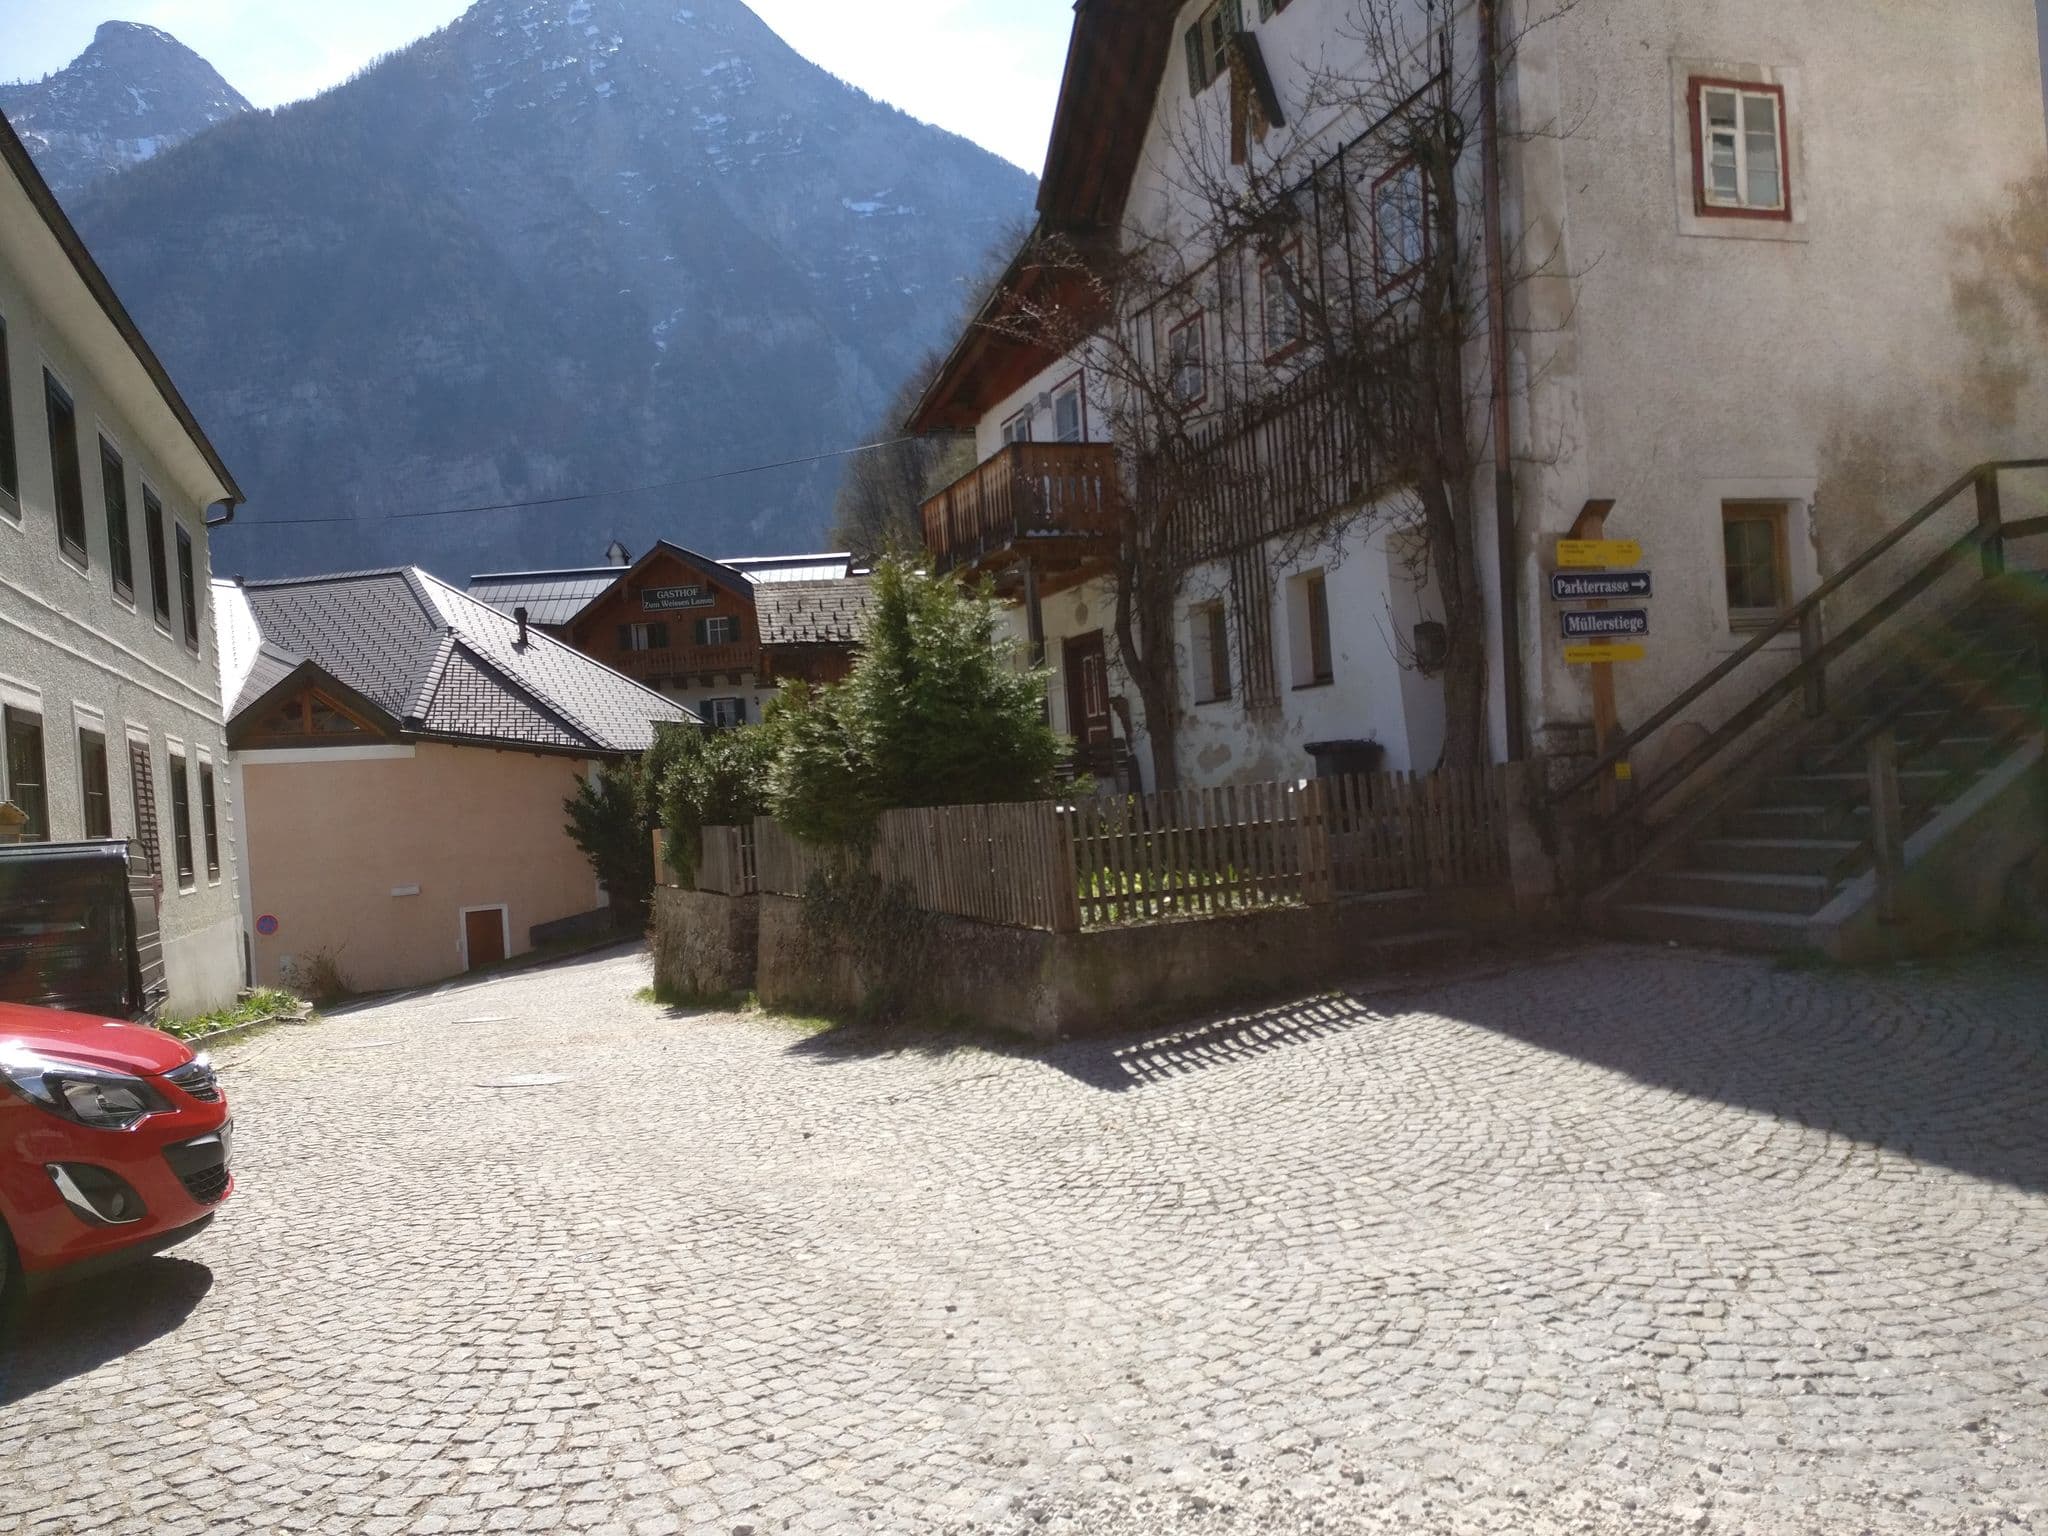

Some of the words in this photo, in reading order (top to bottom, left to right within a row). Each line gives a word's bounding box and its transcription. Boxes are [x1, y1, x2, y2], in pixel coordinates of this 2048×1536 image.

[656, 588, 698, 599] GASTHOF
[1557, 579, 1629, 595] Parkterrasse
[1568, 615, 1644, 633] Müllerstiege
